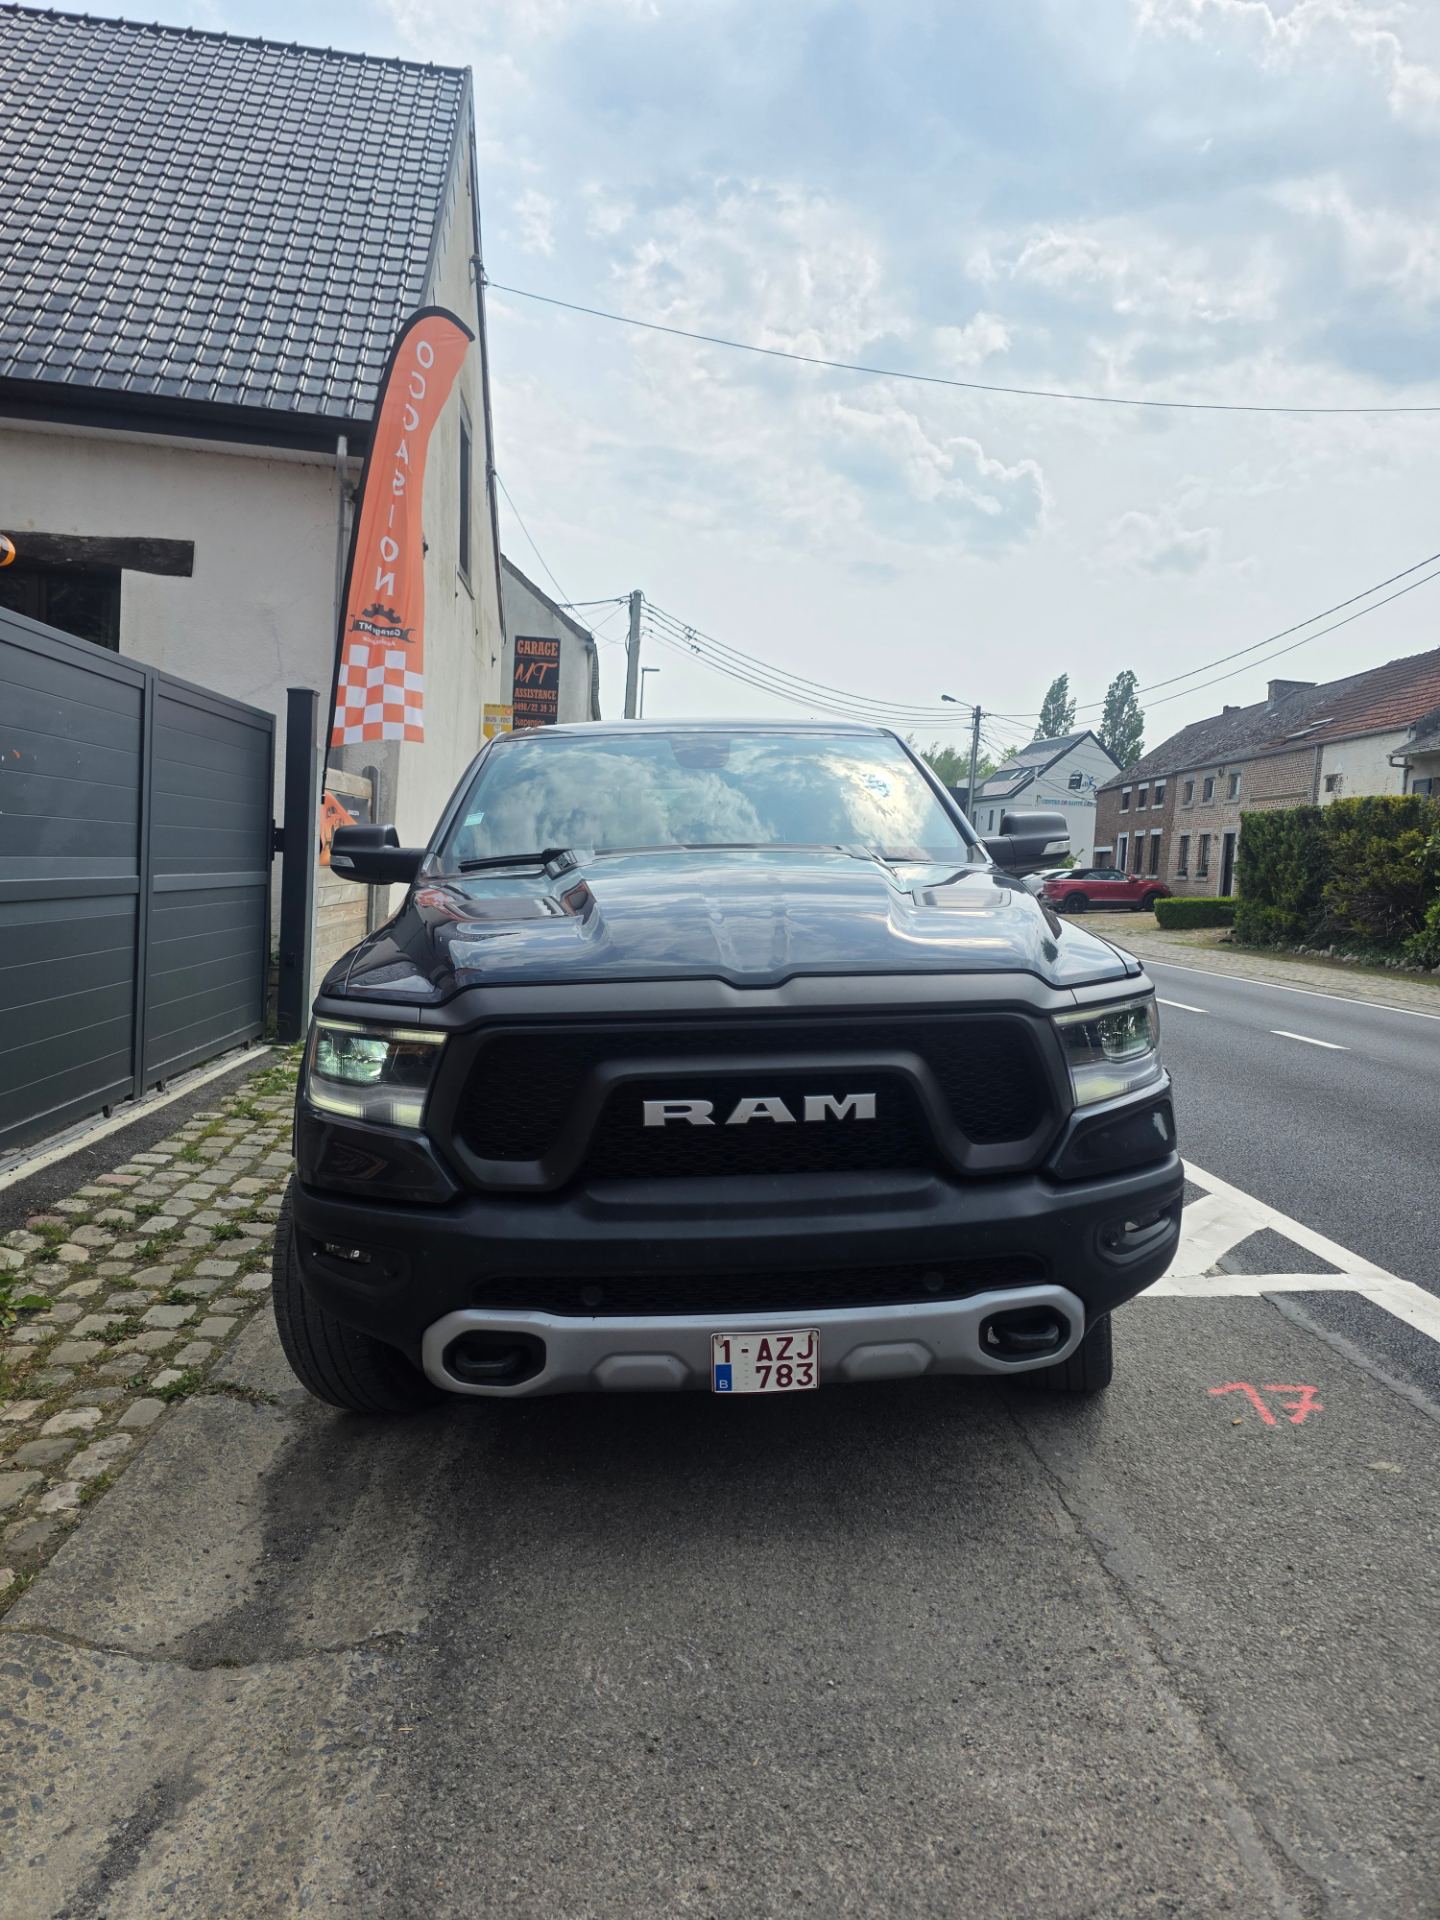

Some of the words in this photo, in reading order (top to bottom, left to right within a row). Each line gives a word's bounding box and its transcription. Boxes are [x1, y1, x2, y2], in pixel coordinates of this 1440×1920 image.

[517, 640, 558, 656] GARAGE
[515, 662, 558, 685] MT
[514, 688, 557, 700] ASSISTANCE
[643, 1093, 876, 1126] RAM
[720, 1379, 728, 1388] B
[755, 1362, 813, 1388] 783
